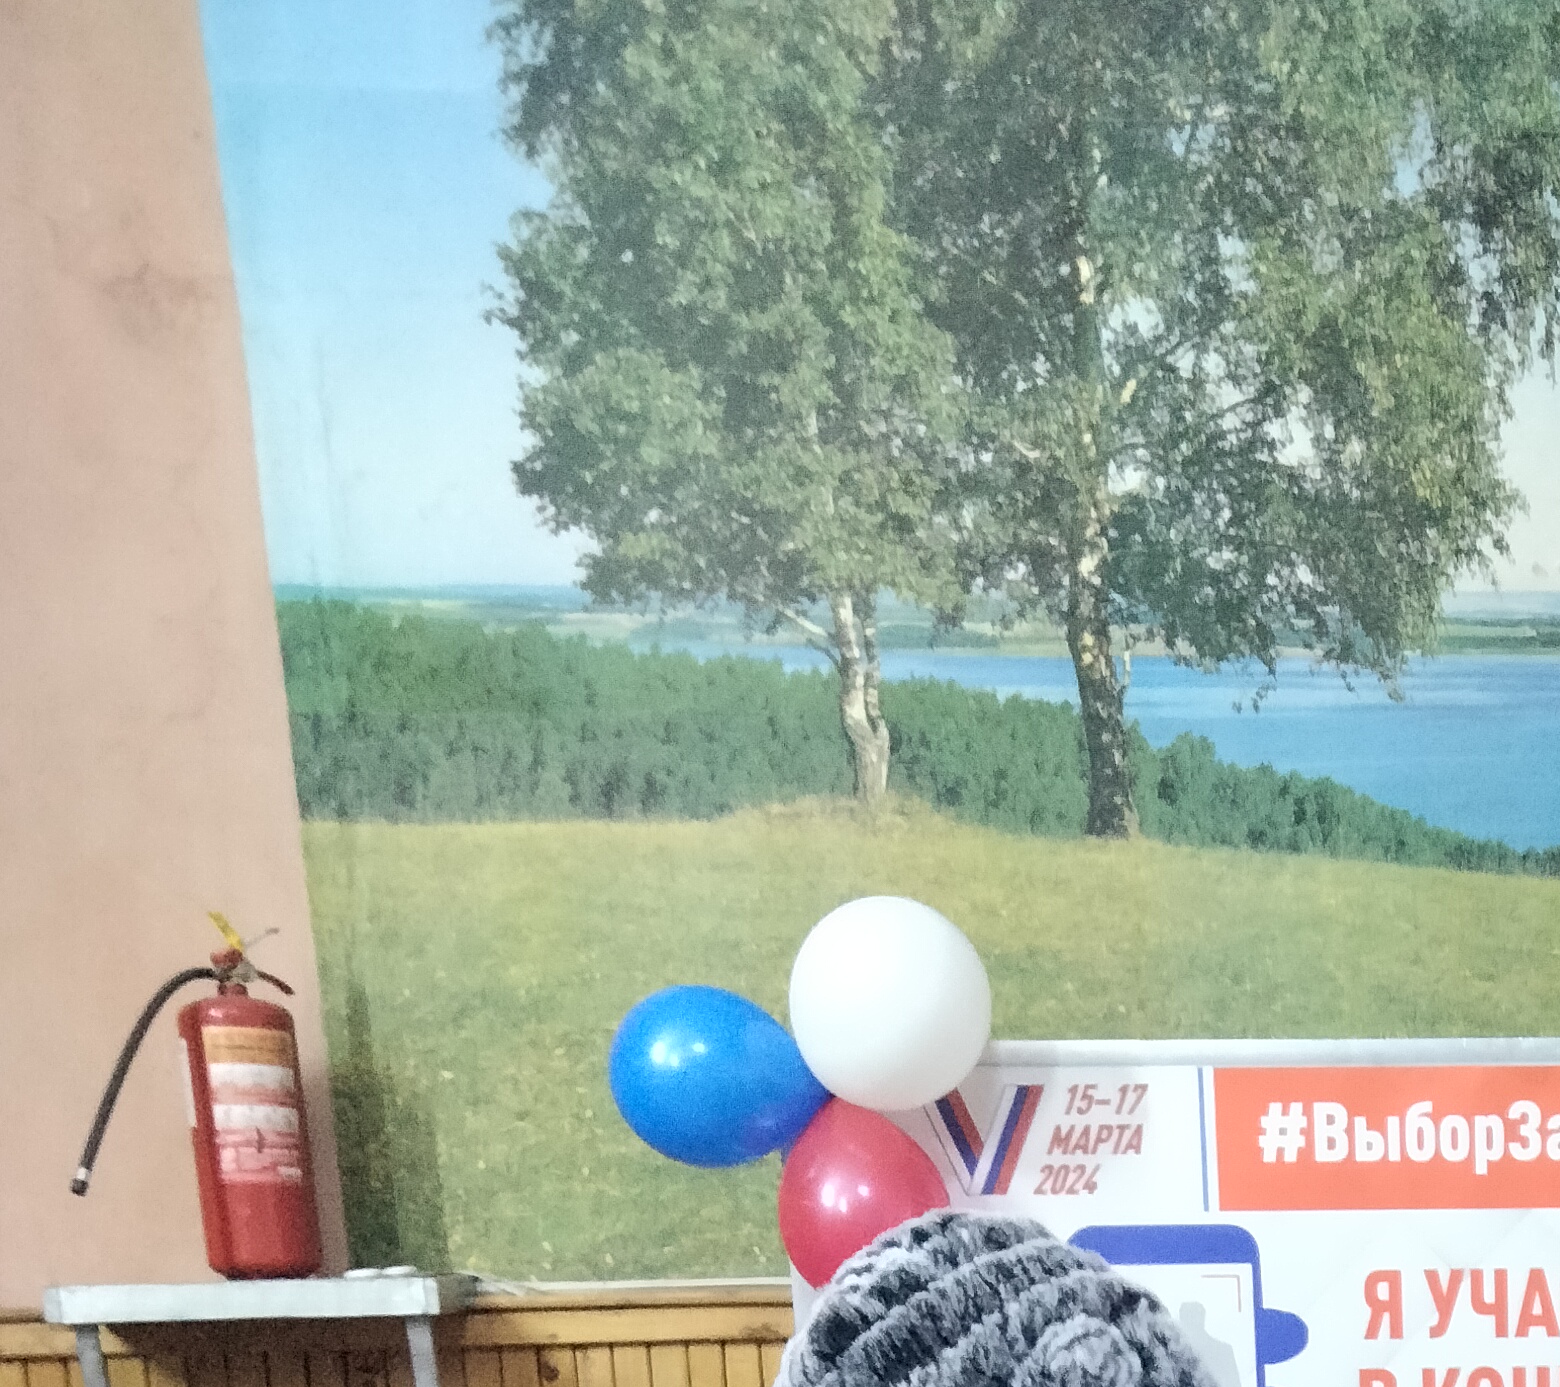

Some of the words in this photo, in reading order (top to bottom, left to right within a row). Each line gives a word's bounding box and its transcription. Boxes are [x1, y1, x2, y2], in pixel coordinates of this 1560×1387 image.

[1047, 1123, 1143, 1155] МАРТА
[1033, 1163, 1101, 1195] 2024
[1363, 1269, 1404, 1340] Я
